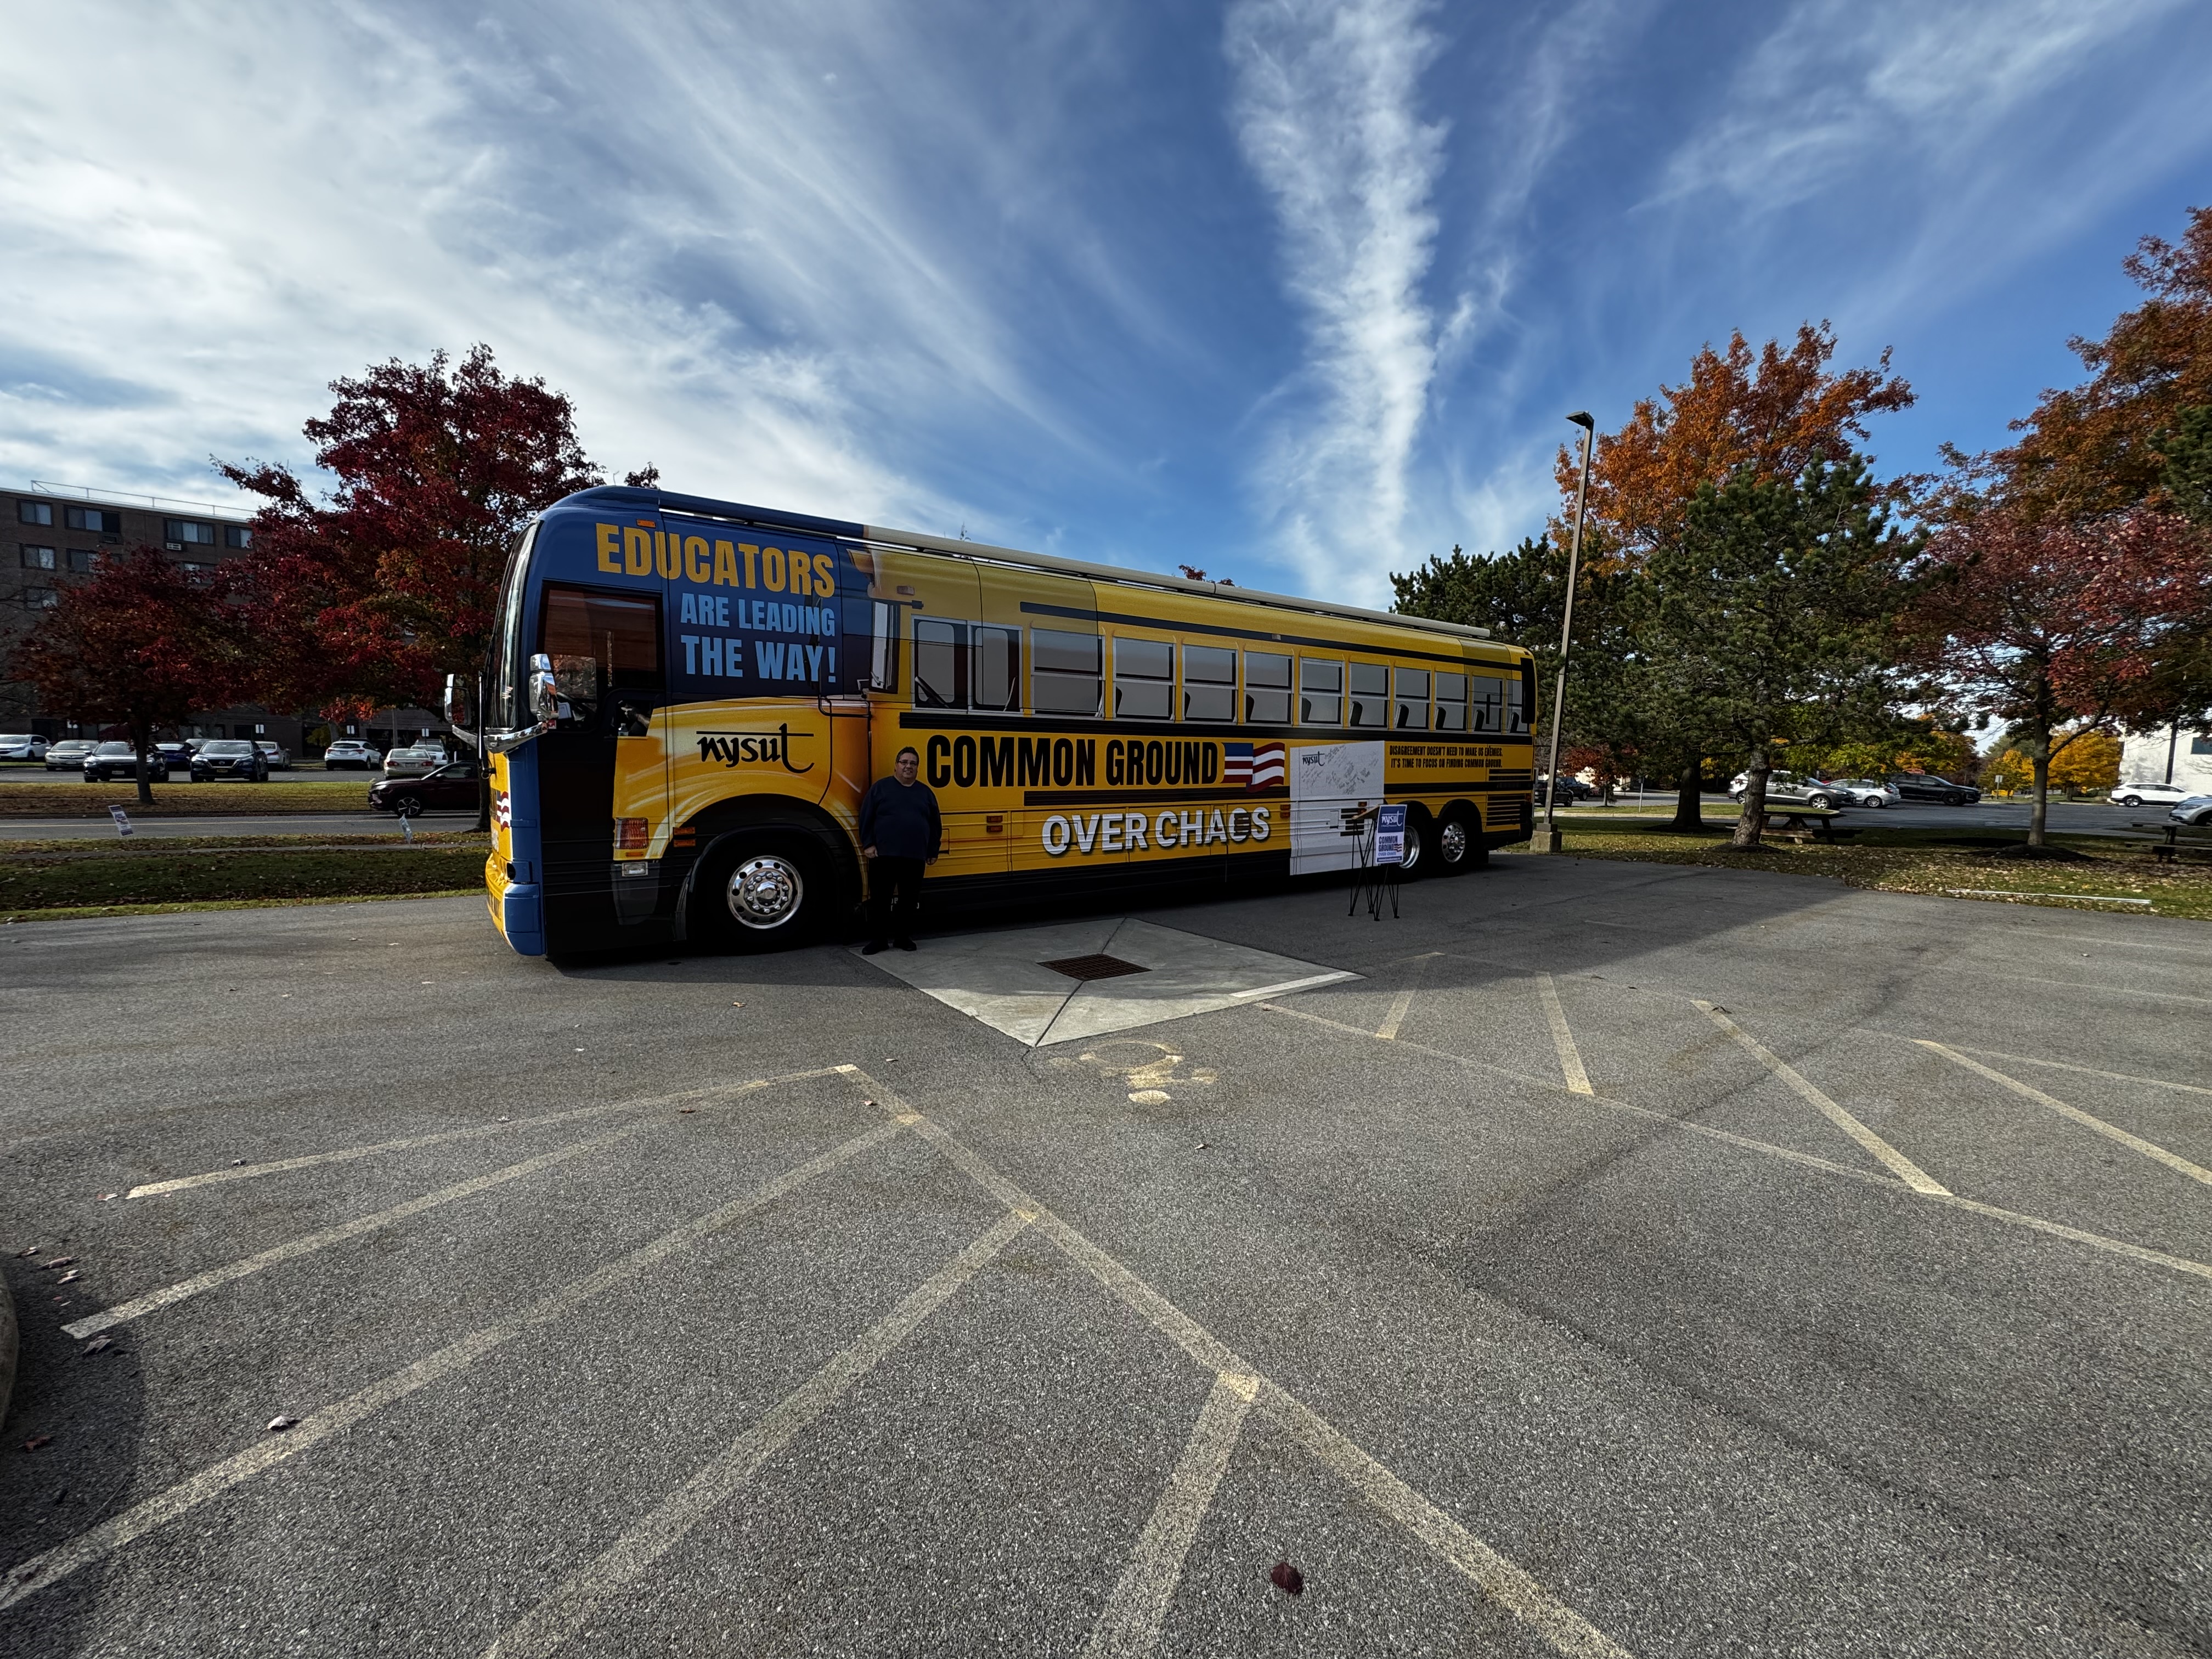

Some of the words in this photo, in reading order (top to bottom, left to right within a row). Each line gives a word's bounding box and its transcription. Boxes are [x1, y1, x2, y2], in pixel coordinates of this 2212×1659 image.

[596, 522, 835, 597] EDUCATORS
[680, 592, 730, 627] ARE
[738, 599, 836, 636] LEADING
[680, 635, 743, 678] THE
[755, 641, 836, 683] WAY!
[696, 723, 815, 774] nysut
[927, 735, 1096, 788] COMMON
[1105, 740, 1218, 786] GROUND
[1302, 751, 1325, 766] nysut
[1389, 745, 1426, 755] DISAGREEMENT
[1427, 746, 1446, 755] DOESN'T
[1447, 747, 1458, 755] NEED
[1458, 747, 1464, 755] TO
[1465, 747, 1477, 756] MAKE
[1478, 747, 1483, 756] US
[1391, 758, 1401, 768] IT'S
[1402, 758, 1414, 768] TIME
[1415, 758, 1421, 768] TO
[1423, 758, 1437, 768] FOCUS
[1438, 759, 1445, 768] ON
[1446, 759, 1463, 768] FINDING
[1465, 759, 1484, 768] COMMON
[1485, 759, 1503, 768] GROUND.
[1042, 810, 1150, 855] OVER
[1155, 806, 1271, 848] CHAOS
[1379, 836, 1398, 844] COMMON
[1381, 810, 1403, 827] nysut
